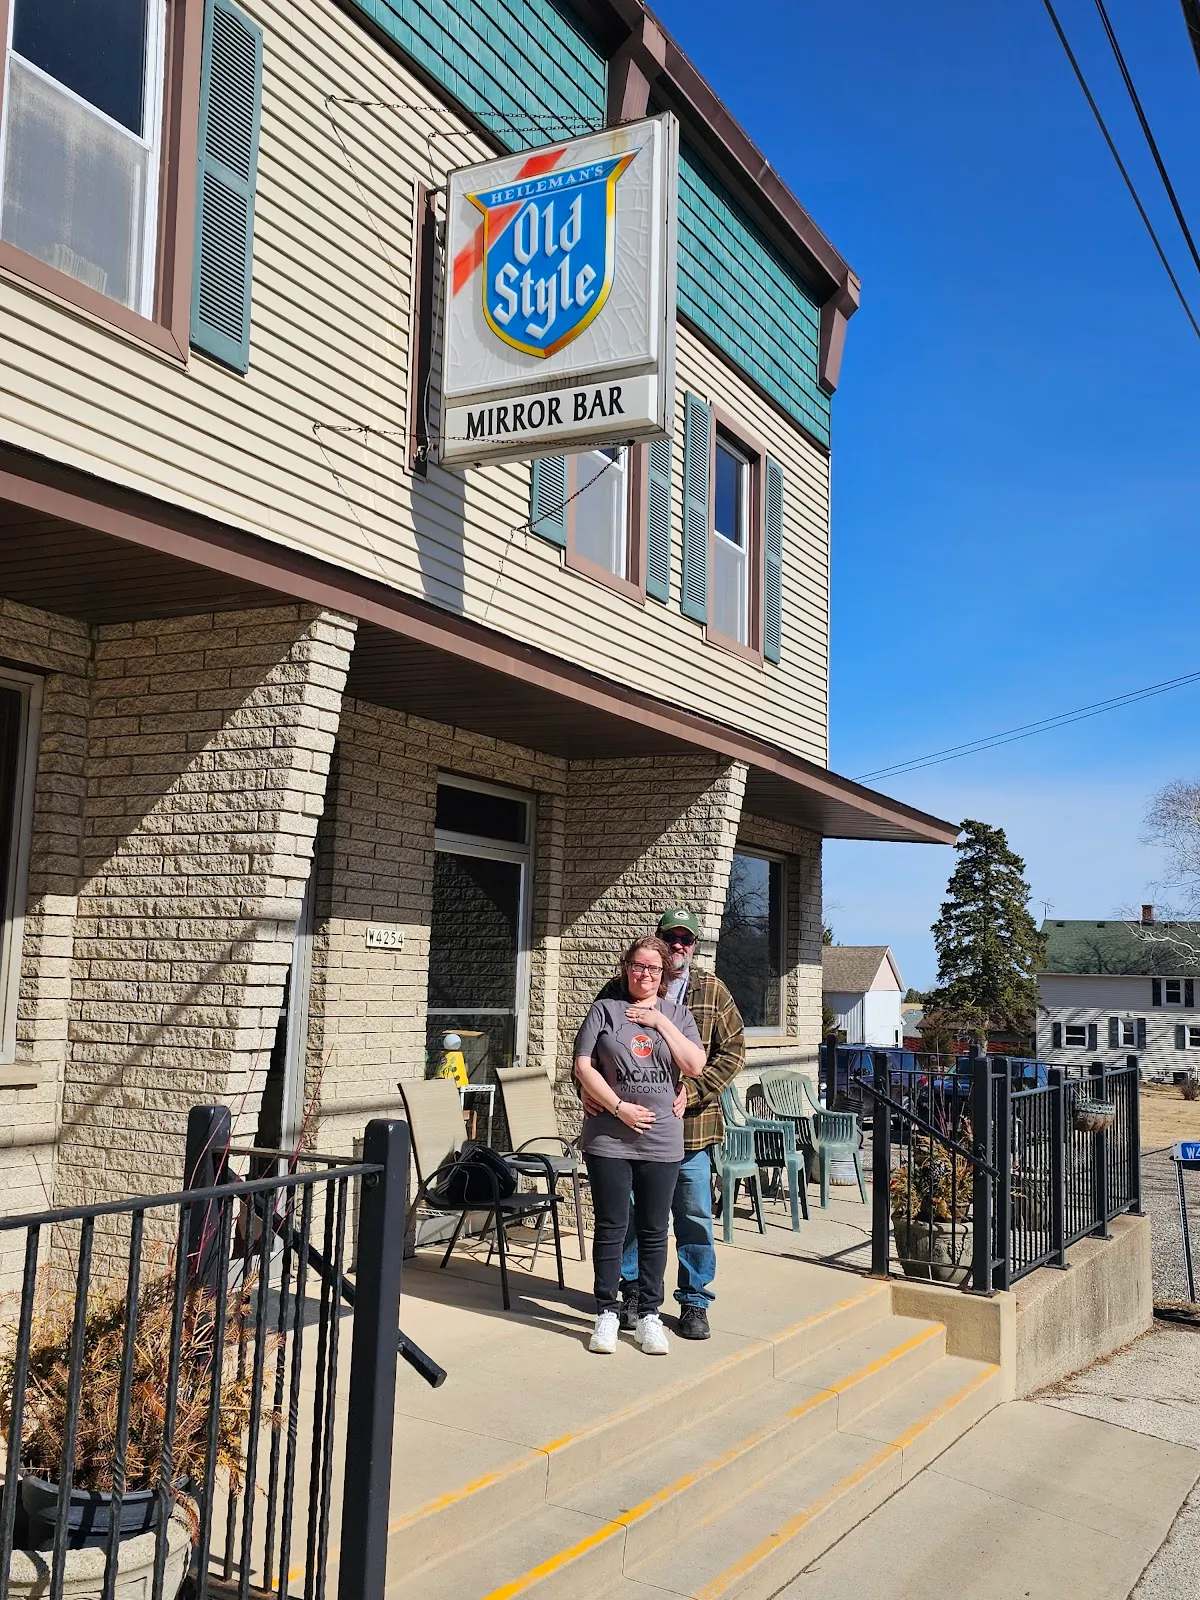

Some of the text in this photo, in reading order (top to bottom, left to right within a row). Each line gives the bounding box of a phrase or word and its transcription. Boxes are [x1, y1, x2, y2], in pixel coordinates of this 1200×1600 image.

[490, 165, 605, 205] HEILEMAN'S
[513, 192, 583, 267] Old
[492, 253, 598, 341] Style
[466, 385, 625, 439] MIRROR BAR
[368, 930, 404, 946] W4254
[616, 1069, 670, 1084] BACARDI
